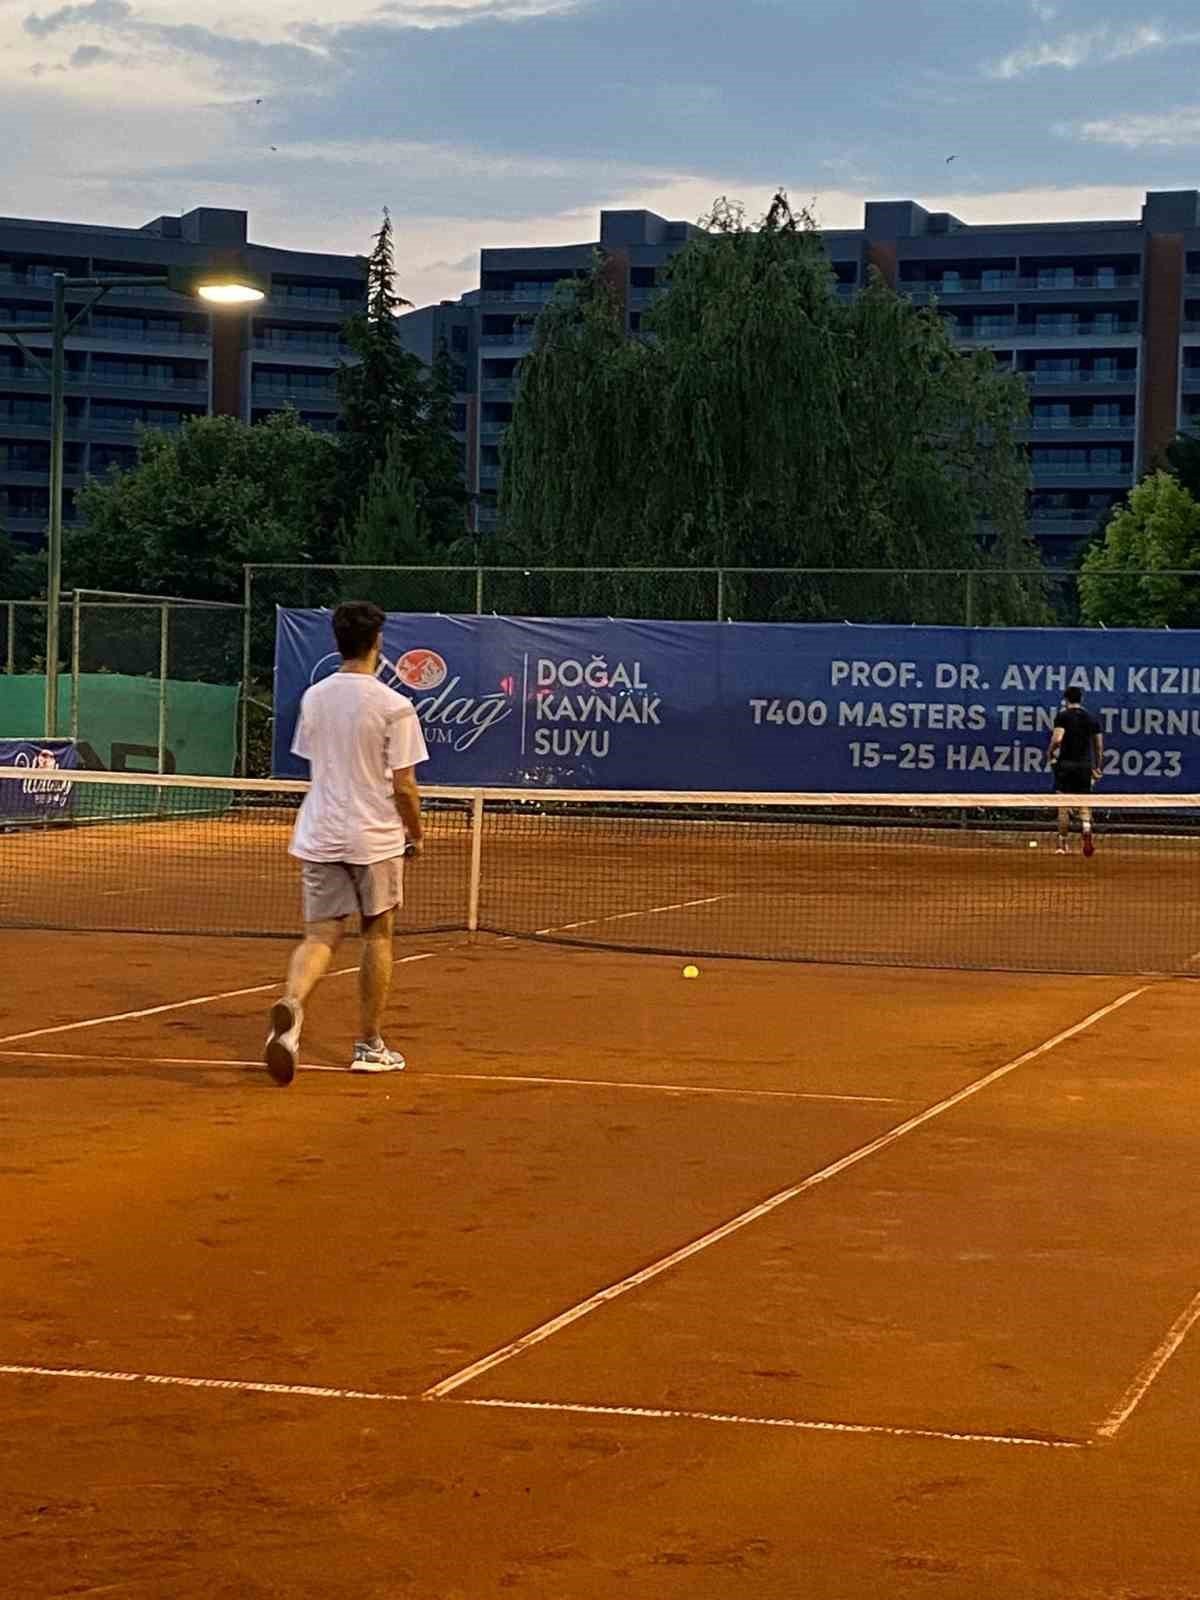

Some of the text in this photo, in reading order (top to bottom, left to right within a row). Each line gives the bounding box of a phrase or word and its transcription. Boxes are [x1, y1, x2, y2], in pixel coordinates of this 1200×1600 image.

[536, 655, 648, 690] DOĞAL
[831, 660, 924, 689] PROF.
[935, 663, 990, 690] DR.
[1000, 664, 1115, 693] AYHAN
[535, 692, 661, 725] KAYNAK
[749, 699, 828, 727] T400
[838, 701, 987, 730] MASTERS
[997, 700, 1067, 732] TEN
[534, 727, 609, 758] SUYU
[849, 740, 1182, 778] 15-25 HAZİR 2023
